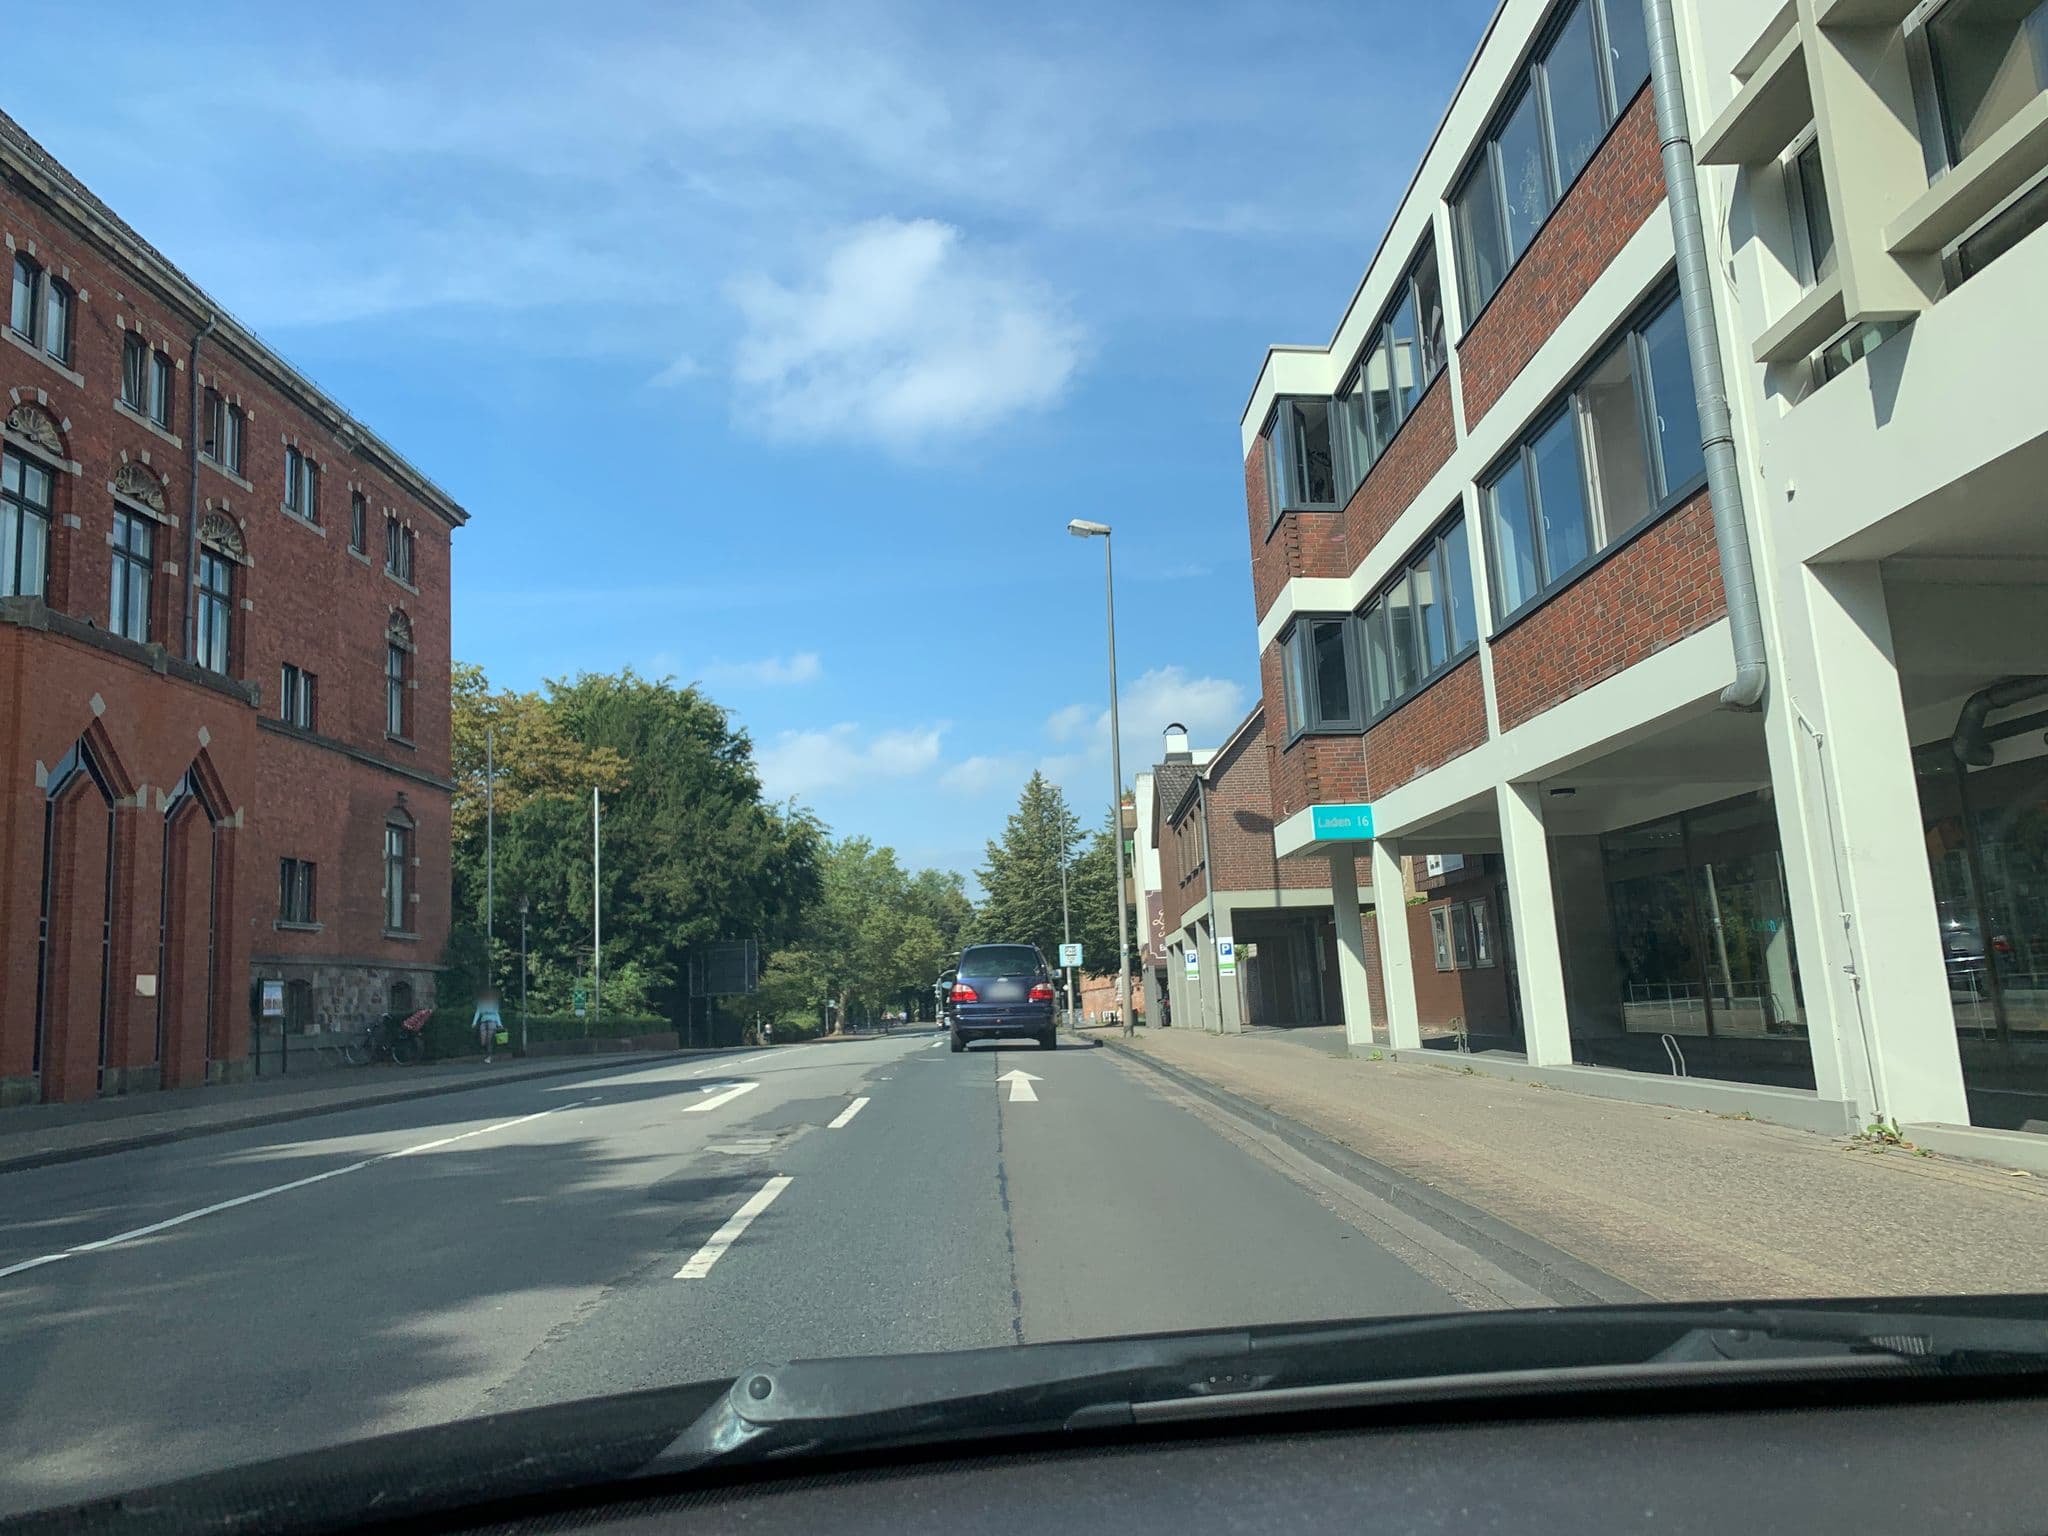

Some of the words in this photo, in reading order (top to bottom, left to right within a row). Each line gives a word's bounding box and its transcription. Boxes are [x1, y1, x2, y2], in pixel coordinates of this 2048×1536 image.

[1318, 815, 1351, 828] Laden
[1357, 815, 1370, 827] 16
[1222, 943, 1231, 955] P
